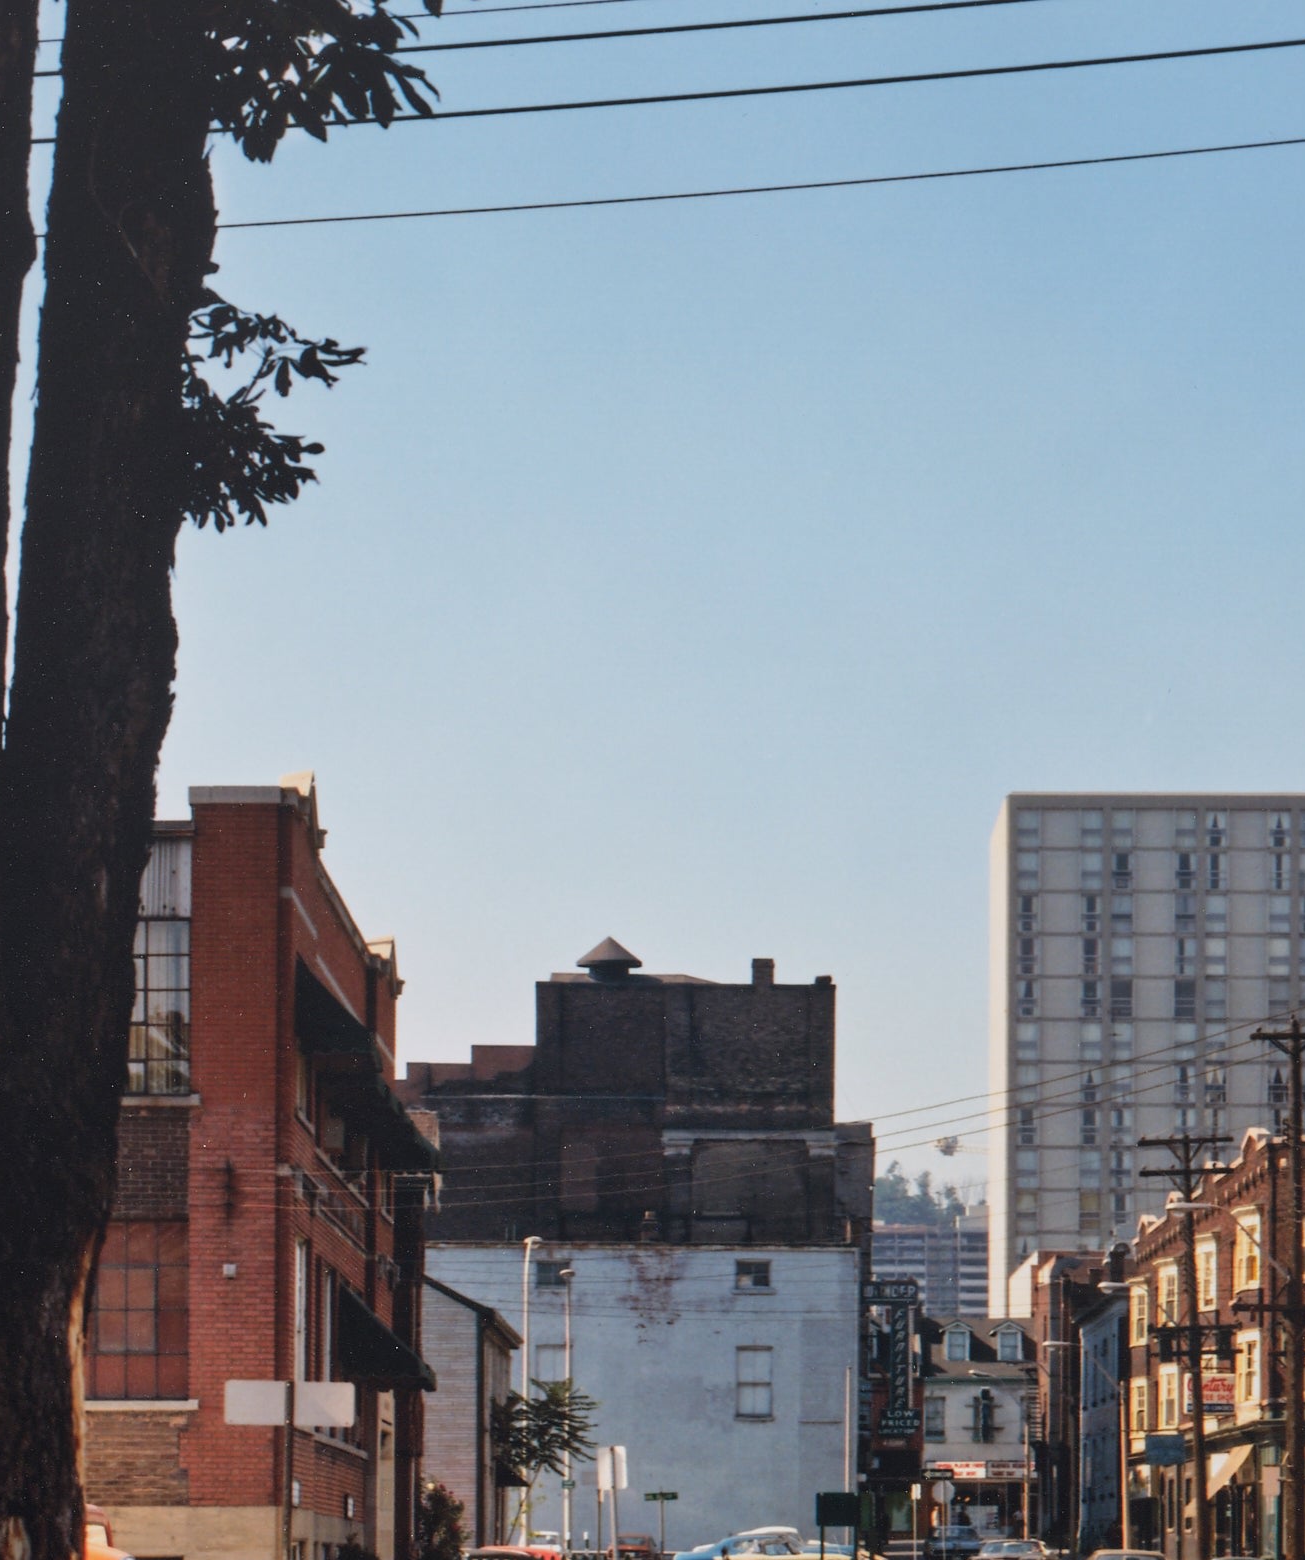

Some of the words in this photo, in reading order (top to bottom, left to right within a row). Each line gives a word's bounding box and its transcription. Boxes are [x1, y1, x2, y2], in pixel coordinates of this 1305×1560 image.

[895, 1308, 906, 1408] FURNITURE
[1187, 1376, 1235, 1393] Cntury
[887, 1410, 914, 1418] LOW
